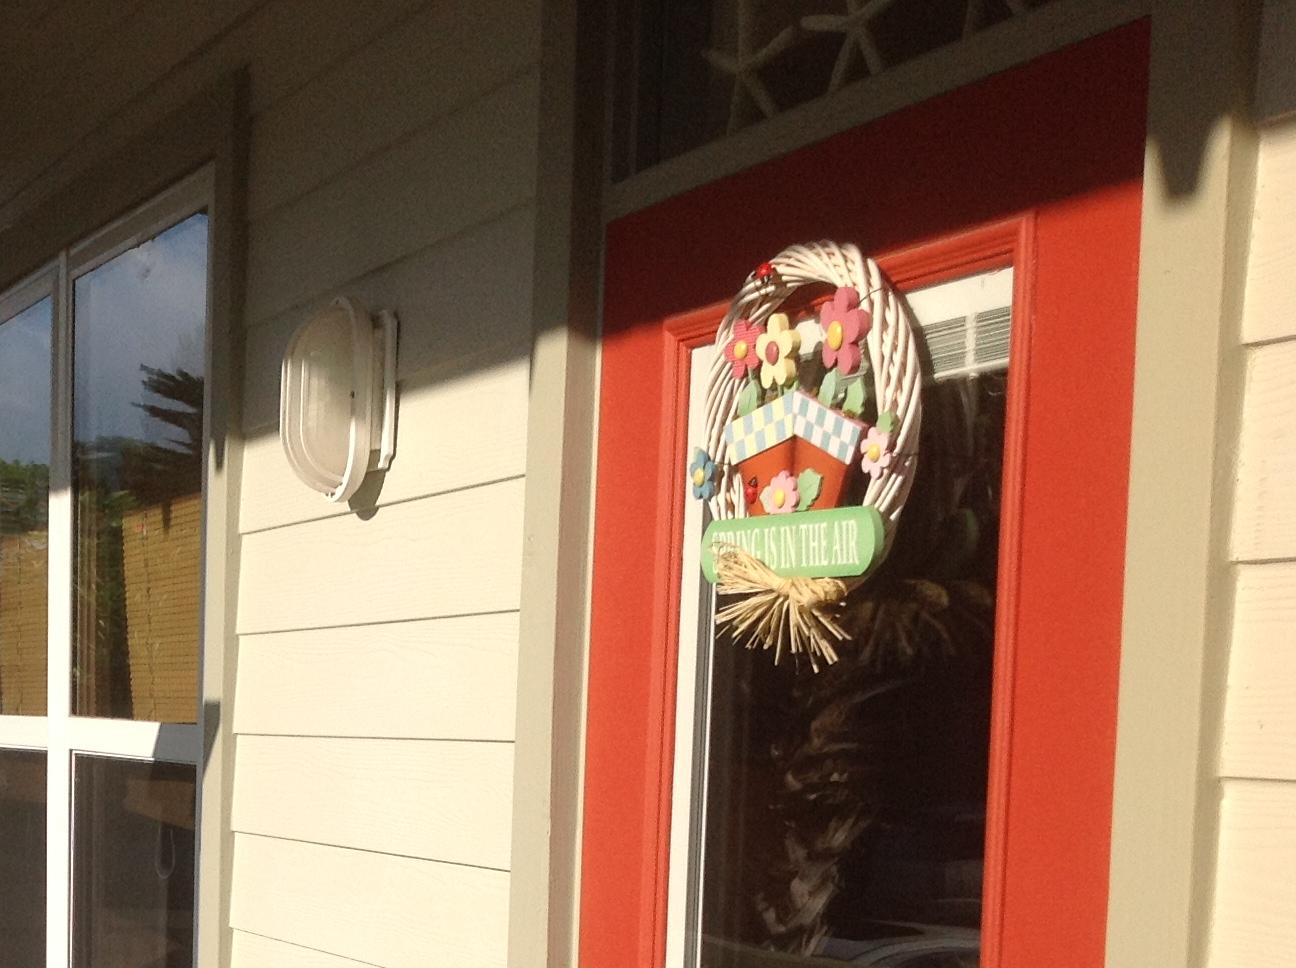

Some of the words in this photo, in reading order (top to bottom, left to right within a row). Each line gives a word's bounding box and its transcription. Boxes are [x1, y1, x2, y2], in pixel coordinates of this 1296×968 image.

[763, 526, 777, 570] IS
[780, 525, 797, 569] IN
[799, 522, 828, 567] THE
[831, 520, 860, 566] AIR
